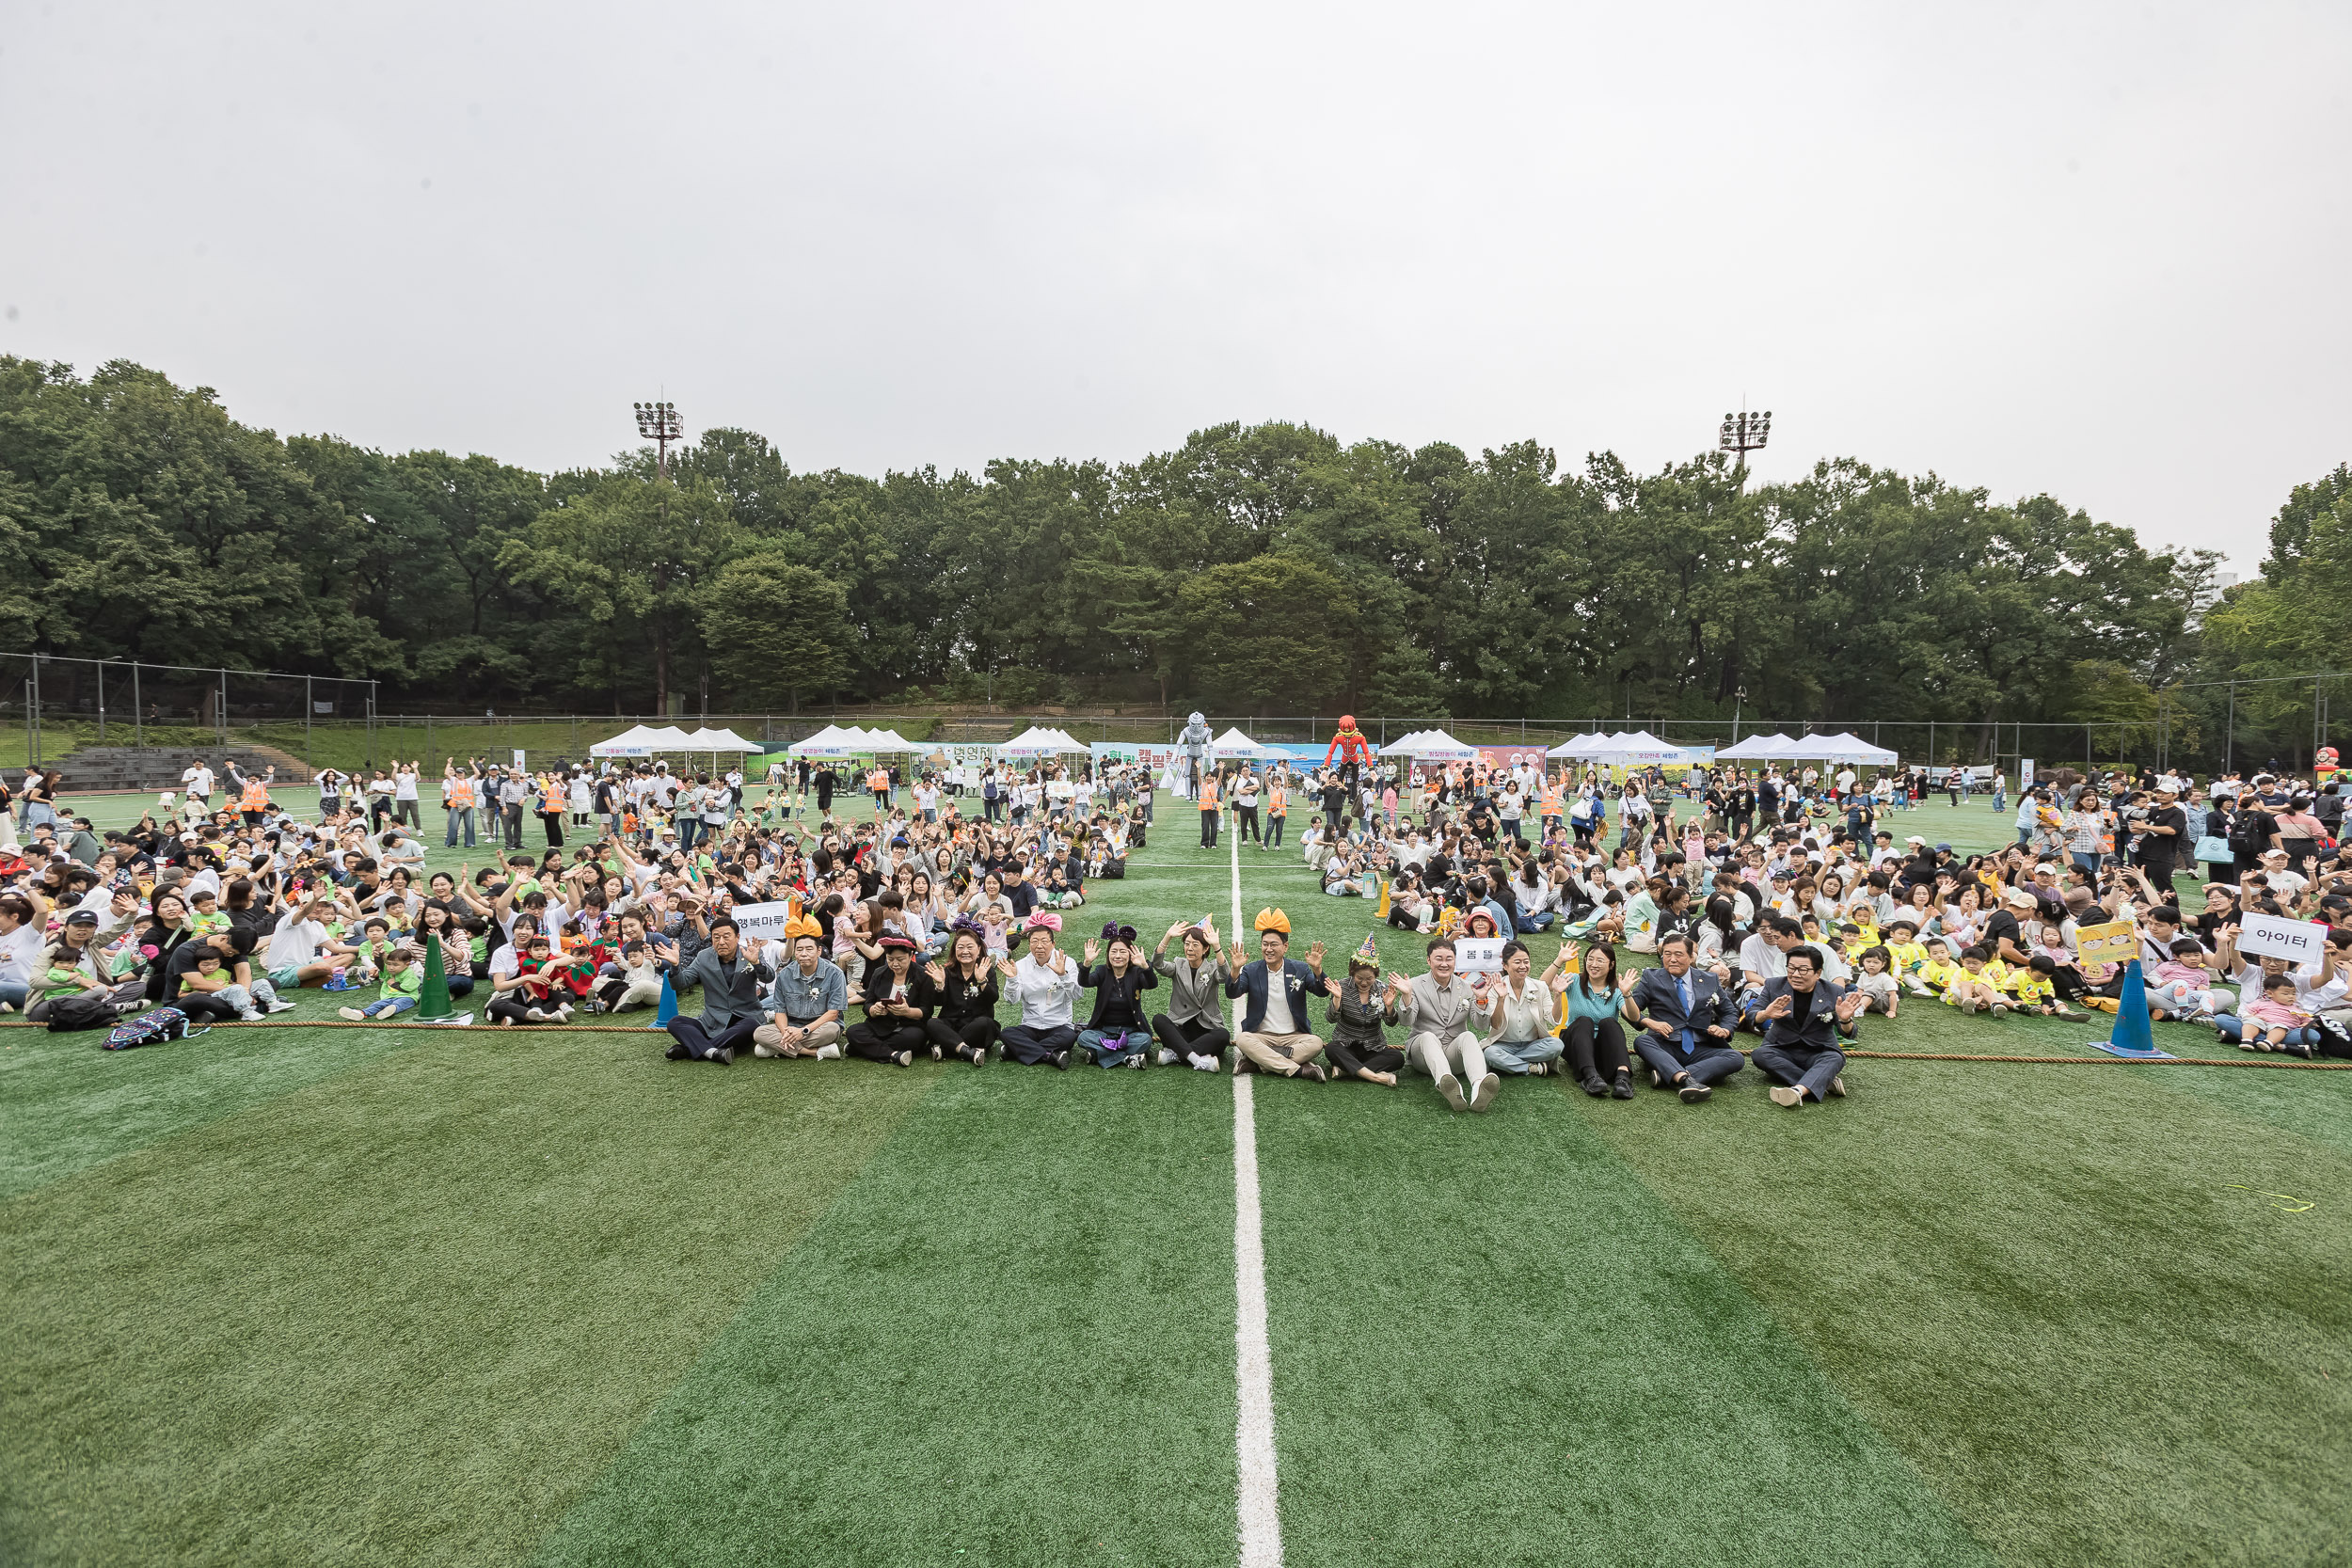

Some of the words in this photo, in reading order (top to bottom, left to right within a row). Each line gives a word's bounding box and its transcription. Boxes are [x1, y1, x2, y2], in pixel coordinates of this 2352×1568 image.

[953, 746, 997, 761] 병영체
[738, 915, 785, 929] 행복마루
[2257, 928, 2309, 949] 아이터
[1467, 949, 1477, 959] 봄
[1483, 949, 1493, 959] 뜰
